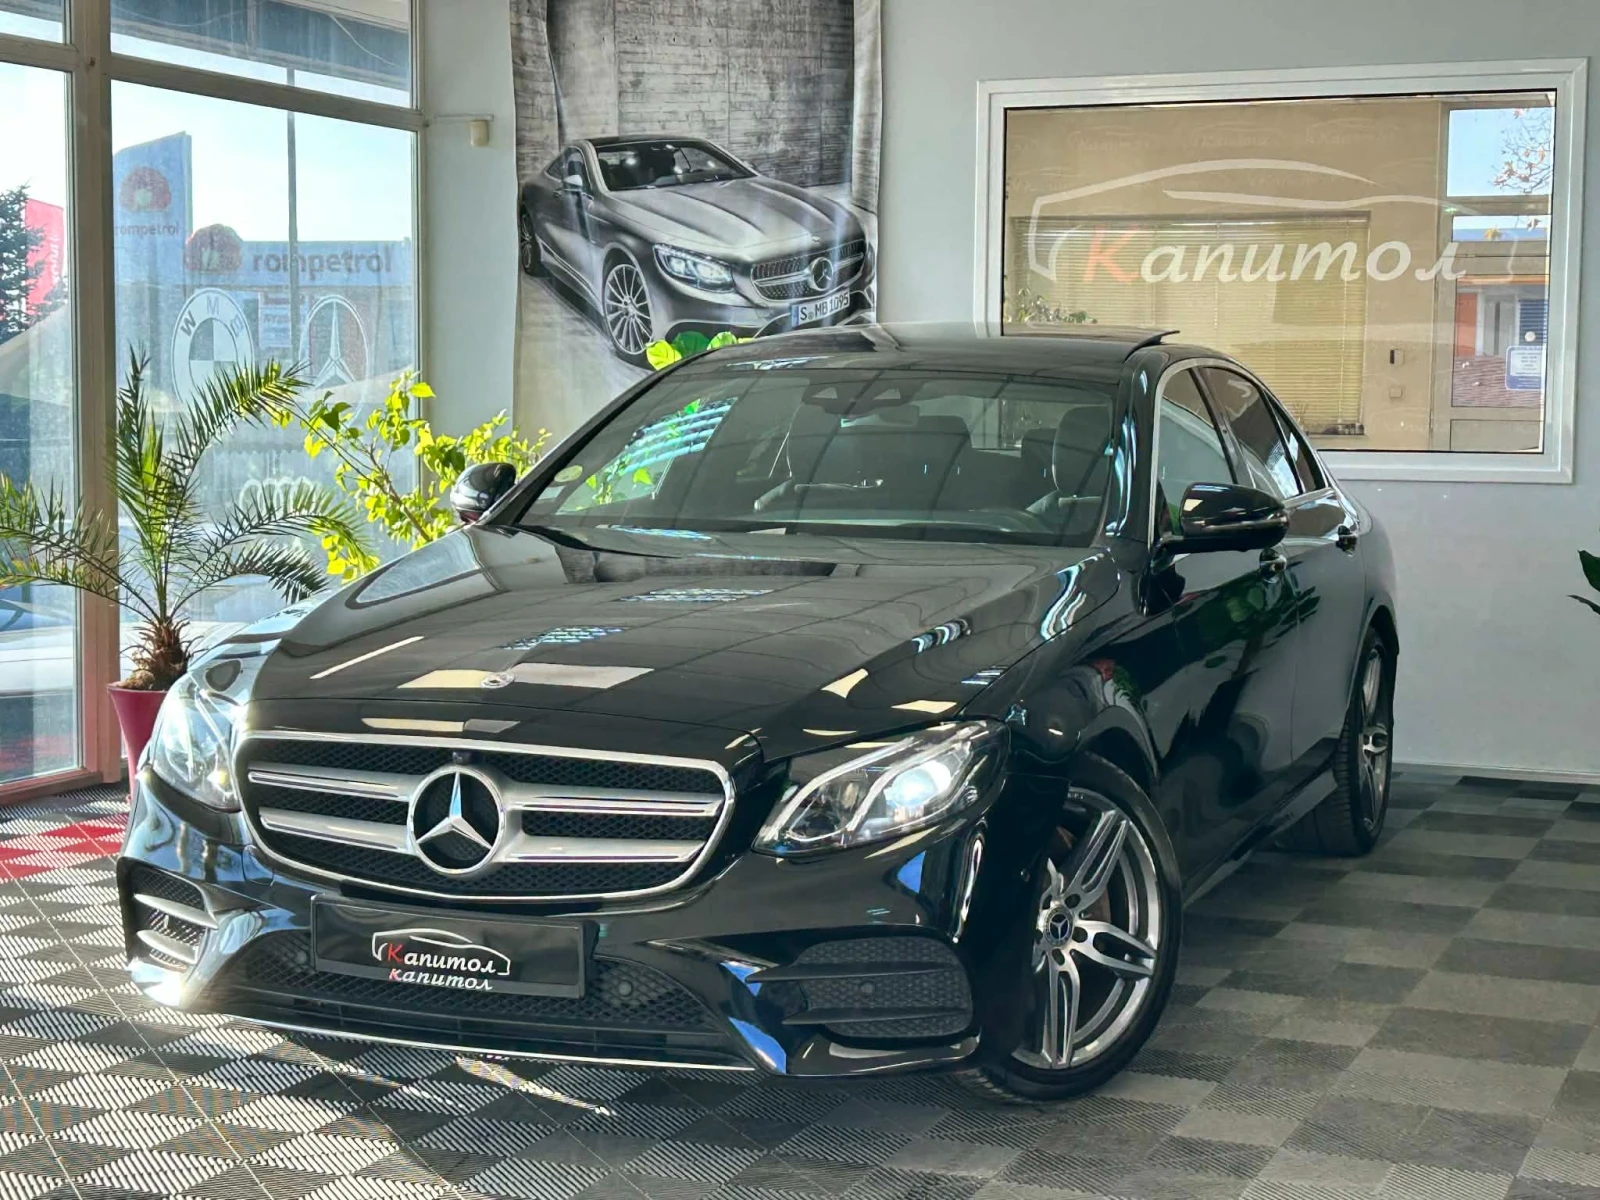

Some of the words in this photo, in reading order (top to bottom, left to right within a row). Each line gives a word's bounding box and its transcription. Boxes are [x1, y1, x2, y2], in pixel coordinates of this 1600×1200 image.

[114, 221, 179, 239] rompetrol
[253, 245, 392, 281] rompetrol
[800, 307, 807, 320] S
